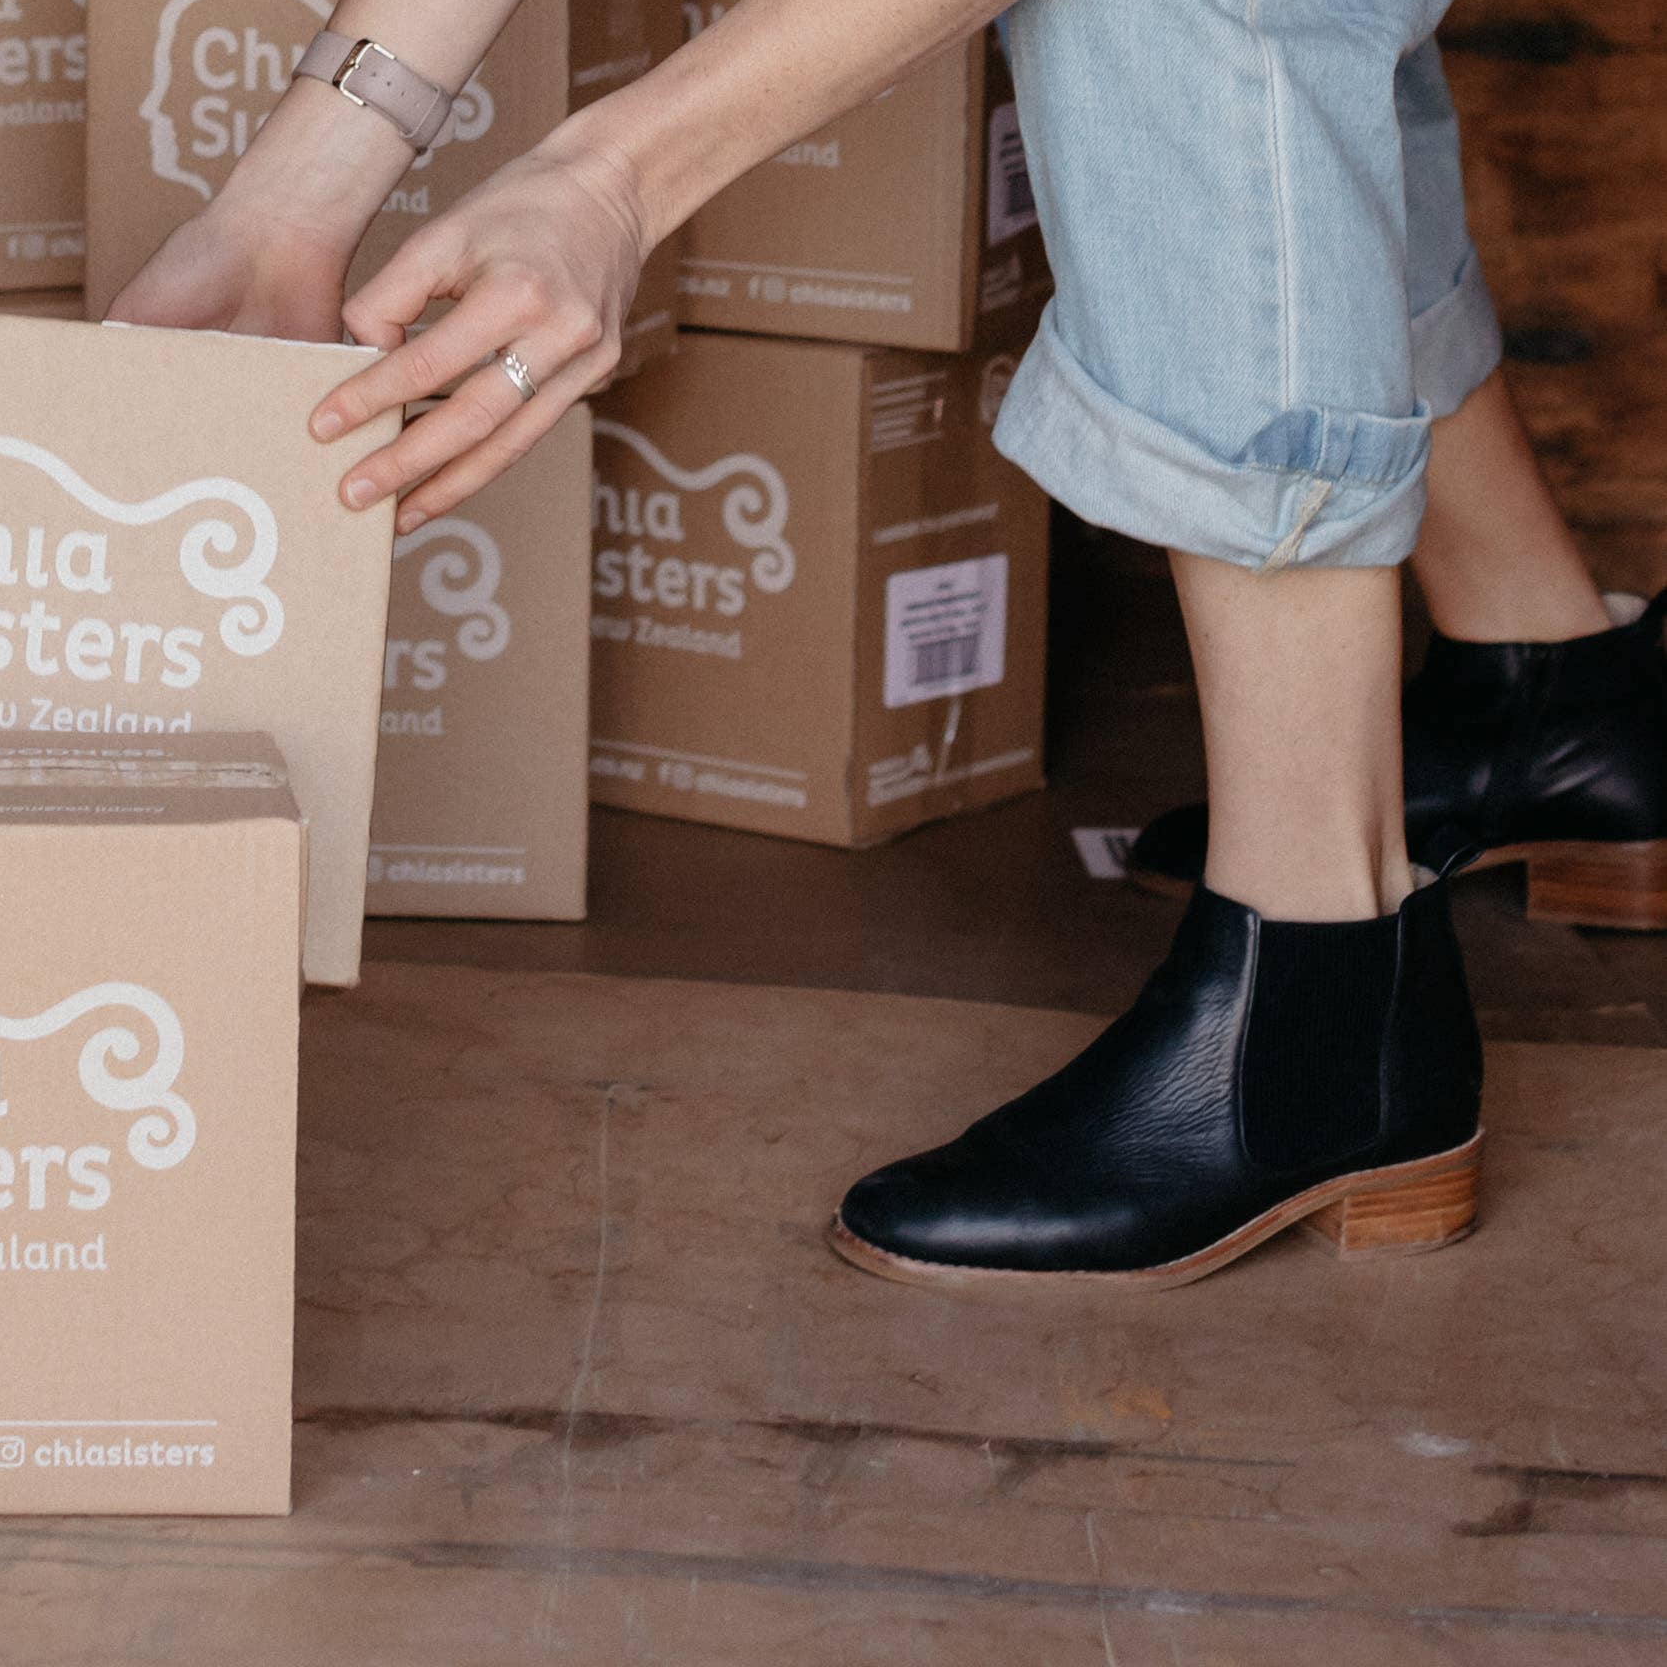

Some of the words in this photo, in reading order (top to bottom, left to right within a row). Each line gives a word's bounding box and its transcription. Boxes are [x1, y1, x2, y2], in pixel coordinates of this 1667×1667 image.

[592, 470, 686, 542] hia
[600, 546, 746, 617] sters
[30, 697, 192, 732] Zealand
[34, 1438, 214, 1467] chiasisters
